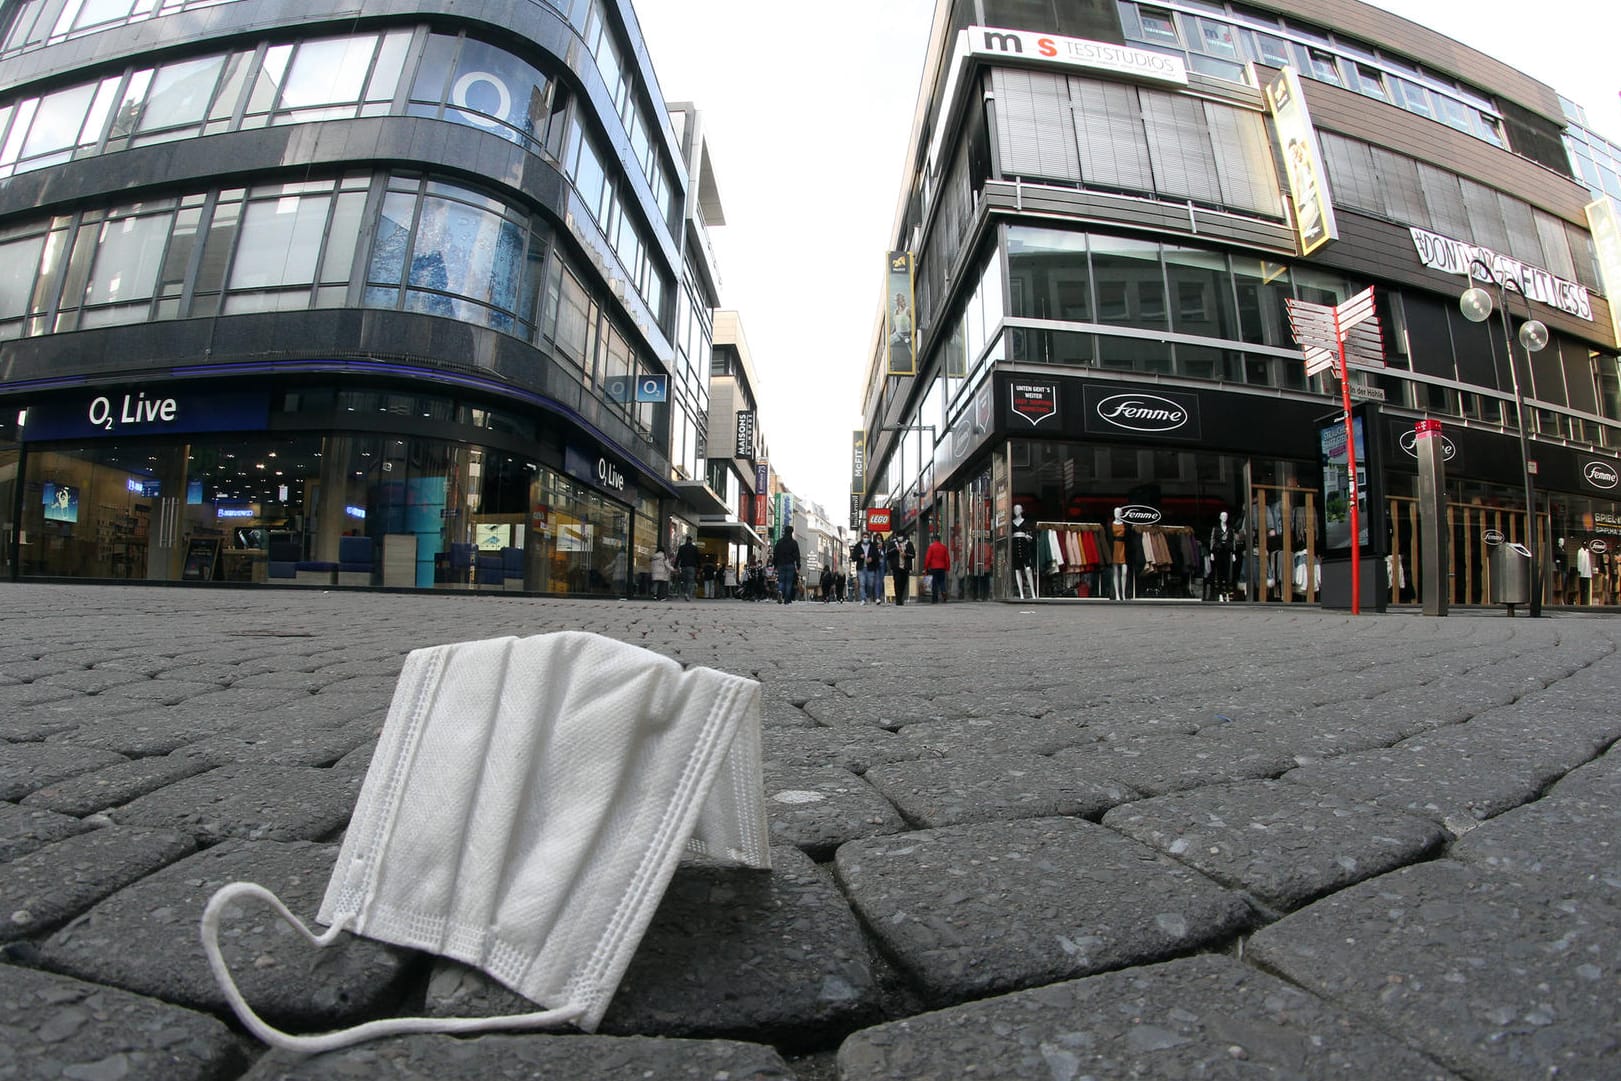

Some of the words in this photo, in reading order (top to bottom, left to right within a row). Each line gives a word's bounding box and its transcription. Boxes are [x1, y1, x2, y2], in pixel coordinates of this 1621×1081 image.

[1064, 40, 1175, 72] TESTSTUDIOS
[121, 392, 178, 422] Live
[737, 414, 746, 455] MAISONS
[608, 463, 625, 492] Live
[869, 514, 889, 525] LEGO
